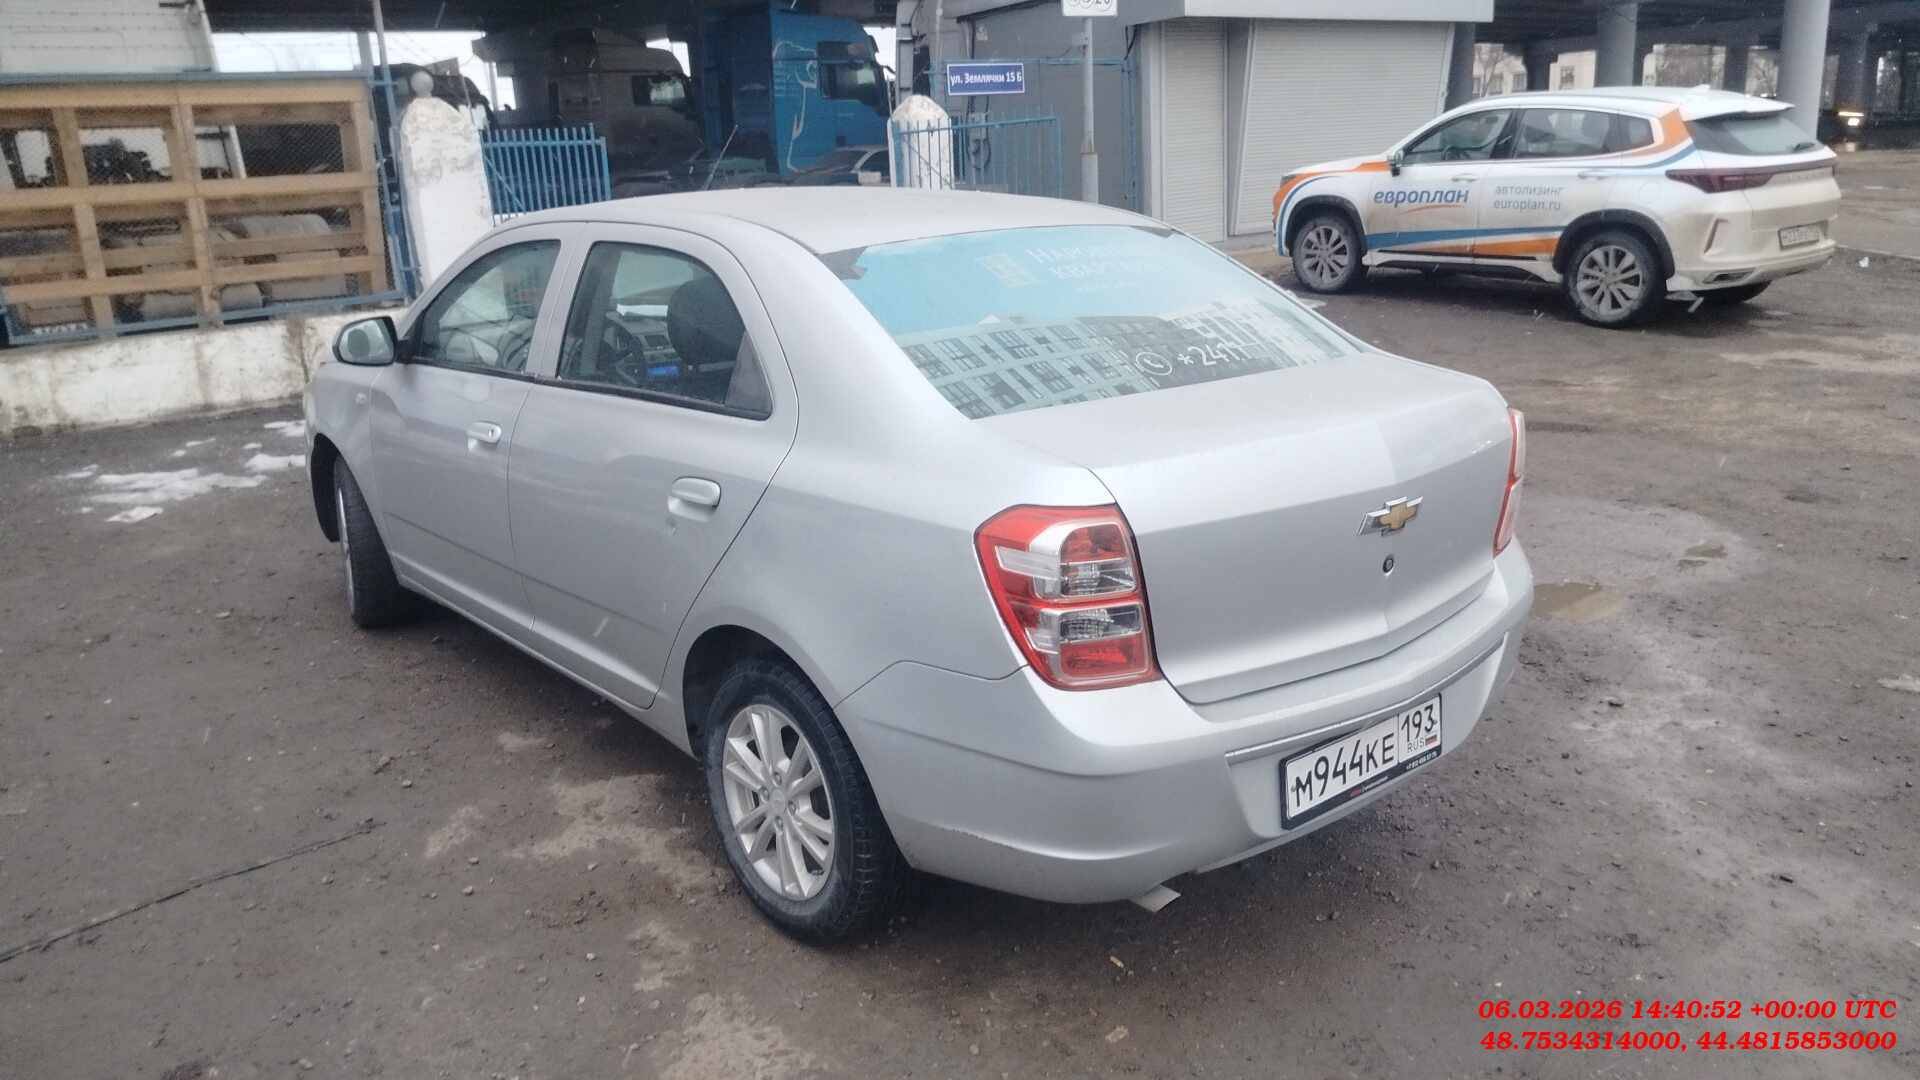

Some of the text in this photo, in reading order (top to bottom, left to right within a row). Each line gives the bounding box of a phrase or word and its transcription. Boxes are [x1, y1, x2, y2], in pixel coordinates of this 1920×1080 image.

[950, 74, 963, 86] ул.
[964, 72, 1005, 84] Землячки
[1006, 71, 1015, 82] 15
[1374, 188, 1469, 208] европлан
[1494, 184, 1564, 197] автолизинг
[1494, 198, 1561, 212] europlan.ru
[1401, 703, 1435, 743] 193
[1407, 736, 1425, 754] RUS
